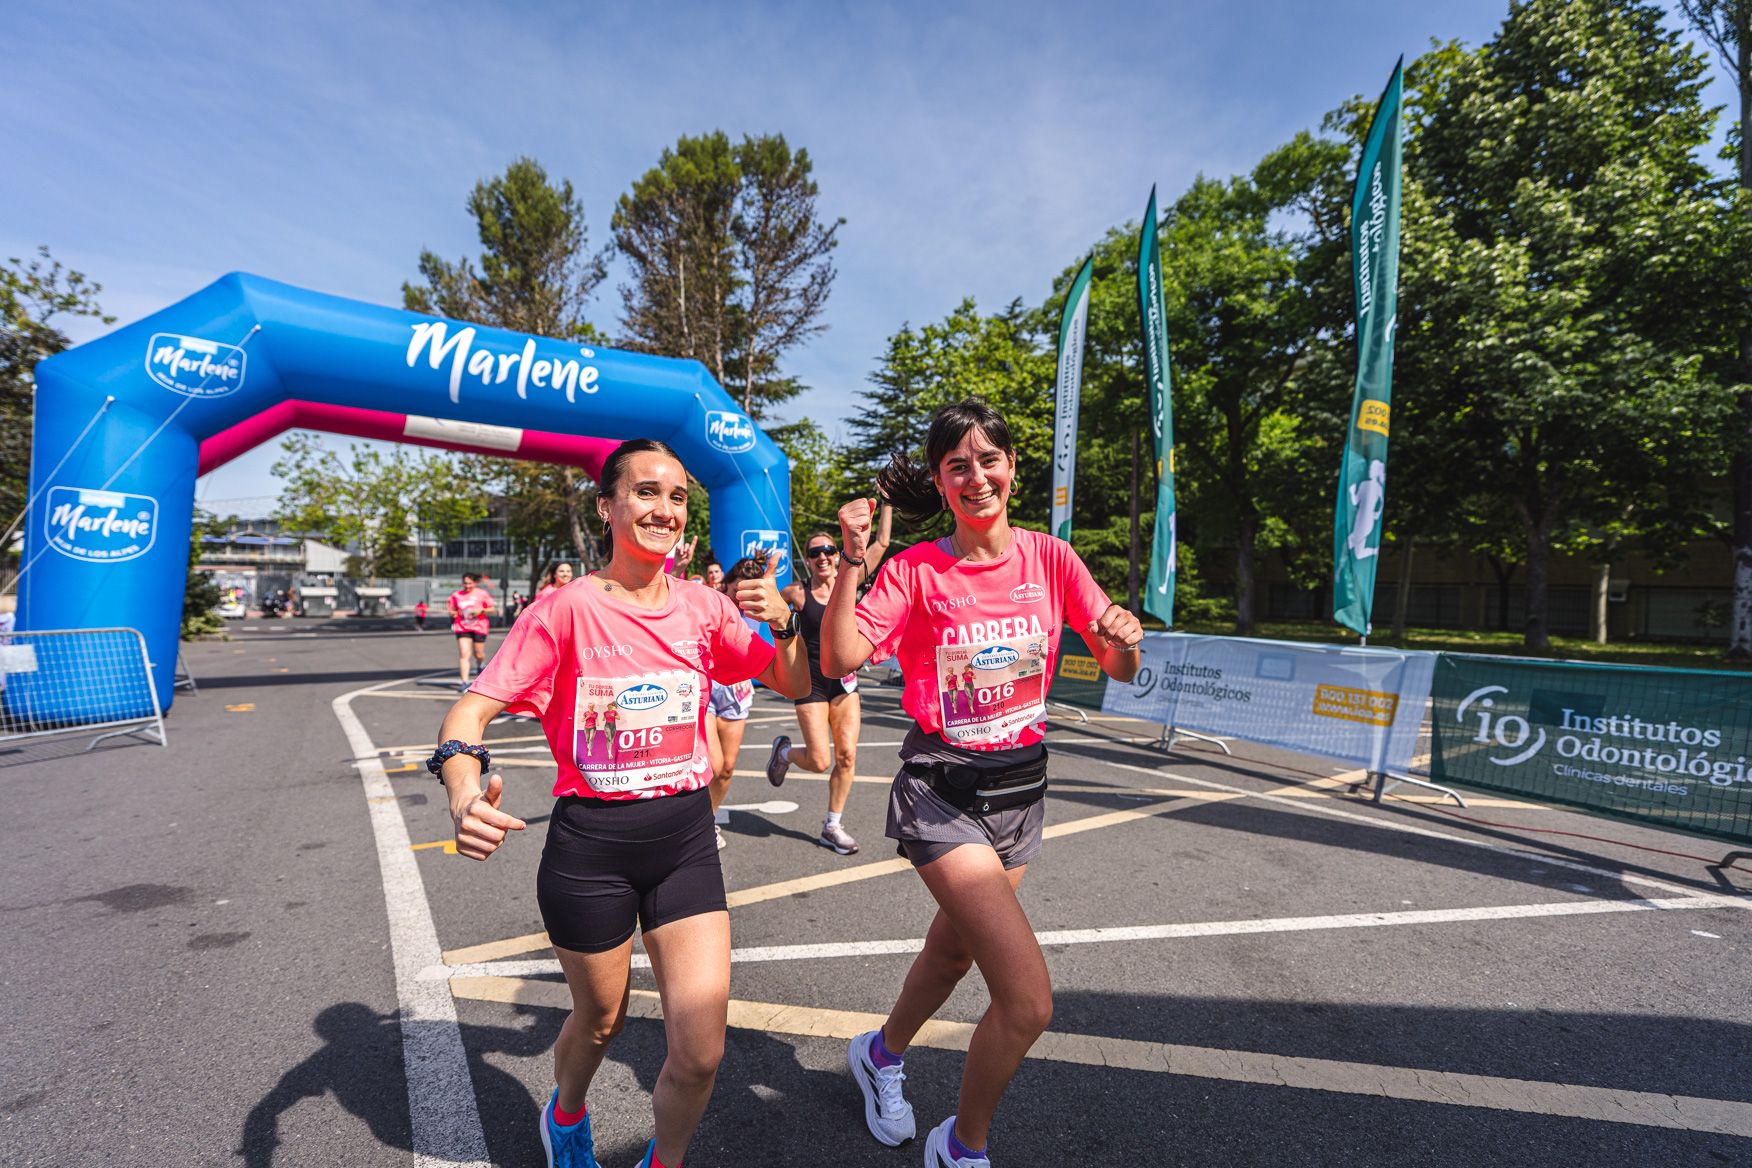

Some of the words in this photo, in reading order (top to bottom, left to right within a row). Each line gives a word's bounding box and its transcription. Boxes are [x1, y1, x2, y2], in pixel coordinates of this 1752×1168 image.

[1360, 220, 1371, 318] Institutos
[406, 322, 599, 404] Marlene
[50, 503, 150, 541] Marlene
[932, 595, 977, 612] OYSHO
[582, 644, 633, 660] OYSHO
[975, 655, 1016, 667] ASTURIANA
[1164, 660, 1222, 680] Institutos
[589, 689, 614, 697] SUMA
[977, 681, 1015, 704] 016
[1161, 677, 1251, 703] Odontológicos
[620, 694, 665, 705] ASTURIANA
[947, 717, 972, 727] CARRERA
[1008, 712, 1035, 726] Santander
[957, 726, 992, 738] OYSHO
[1560, 708, 1721, 748] Institutos
[618, 727, 663, 749] 016
[633, 749, 649, 759] 211
[625, 761, 646, 769] MUJER
[588, 775, 629, 786] OYSHO
[653, 769, 684, 781] Santander
[1553, 763, 1612, 783] Clínicas
[1613, 774, 1688, 796] dentales
